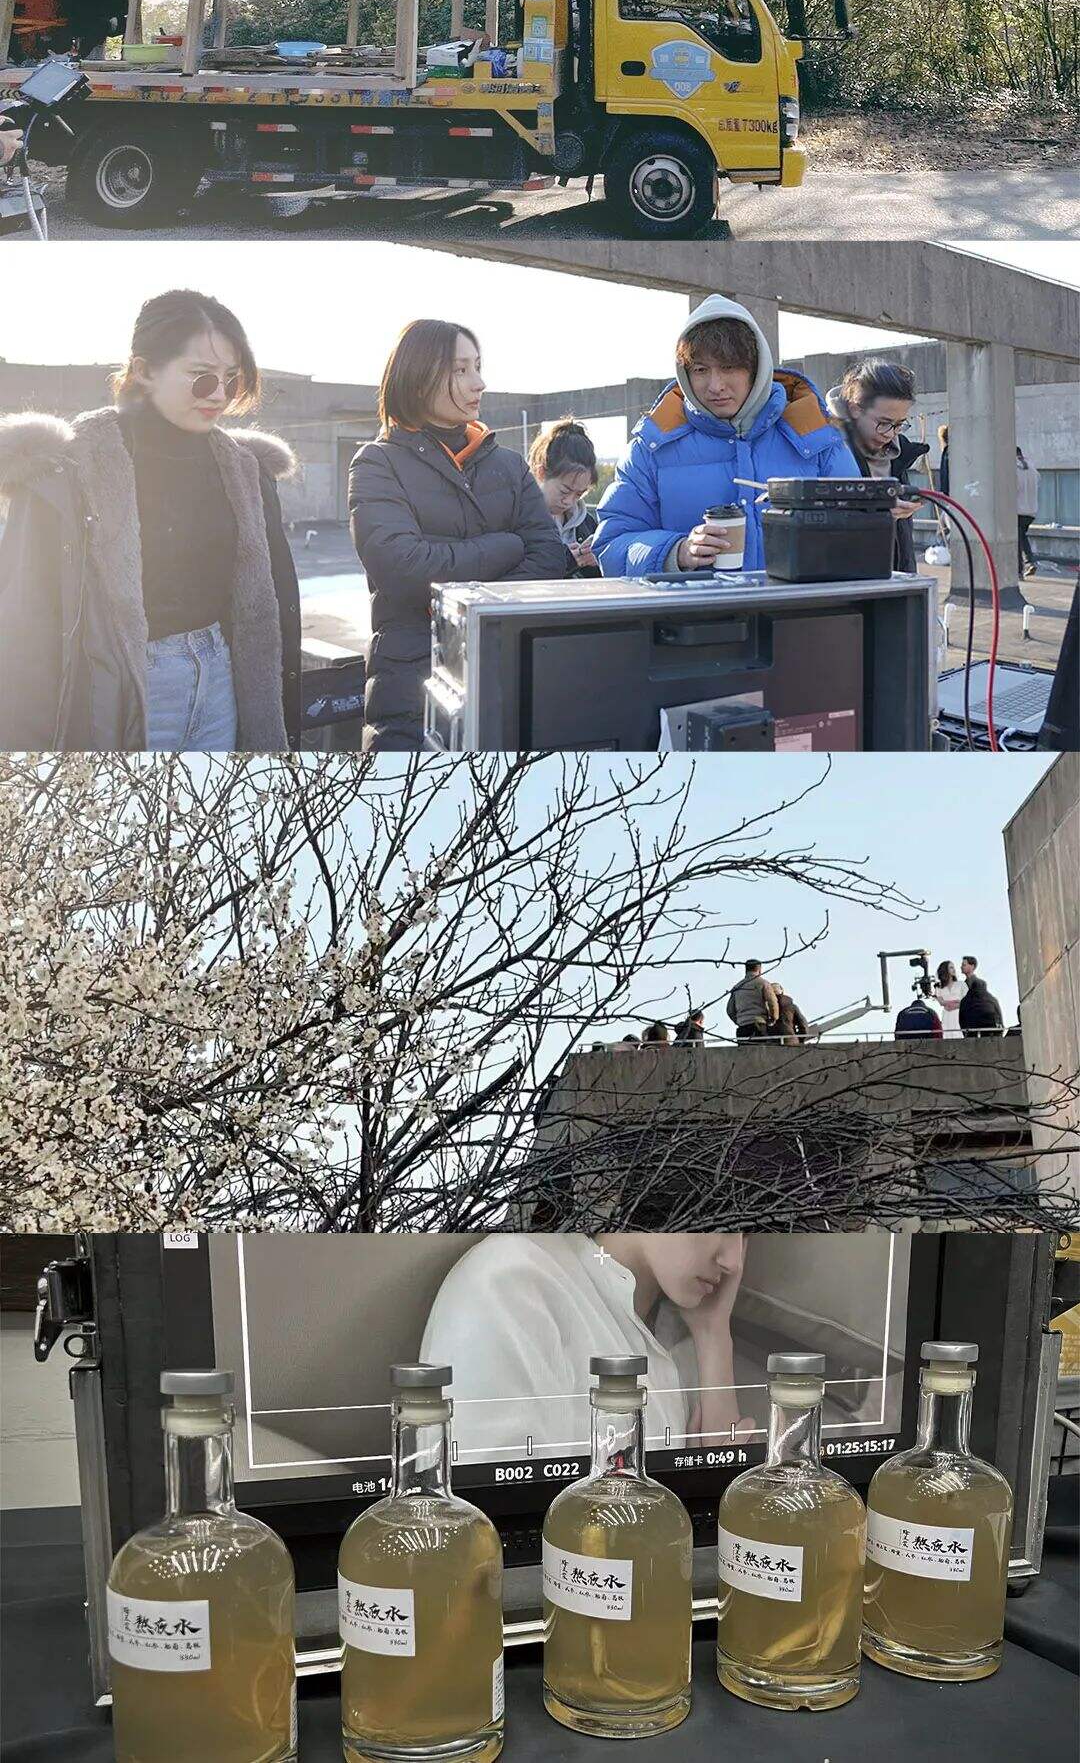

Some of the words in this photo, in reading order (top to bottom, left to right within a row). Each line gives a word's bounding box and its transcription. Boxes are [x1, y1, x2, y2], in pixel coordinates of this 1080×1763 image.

[170, 1233, 191, 1243] LOG
[826, 1438, 896, 1456] 01:25:15:17
[674, 1454, 704, 1467] 存储卡
[706, 1451, 735, 1465] 0:49
[738, 1448, 747, 1463] h
[495, 1465, 533, 1482] B002
[543, 1462, 580, 1477] C022
[352, 1481, 376, 1494] 电池
[912, 1535, 968, 1555] 熬夜水
[743, 1550, 798, 1573] 熬夜水
[570, 1567, 626, 1590] 熬夜水
